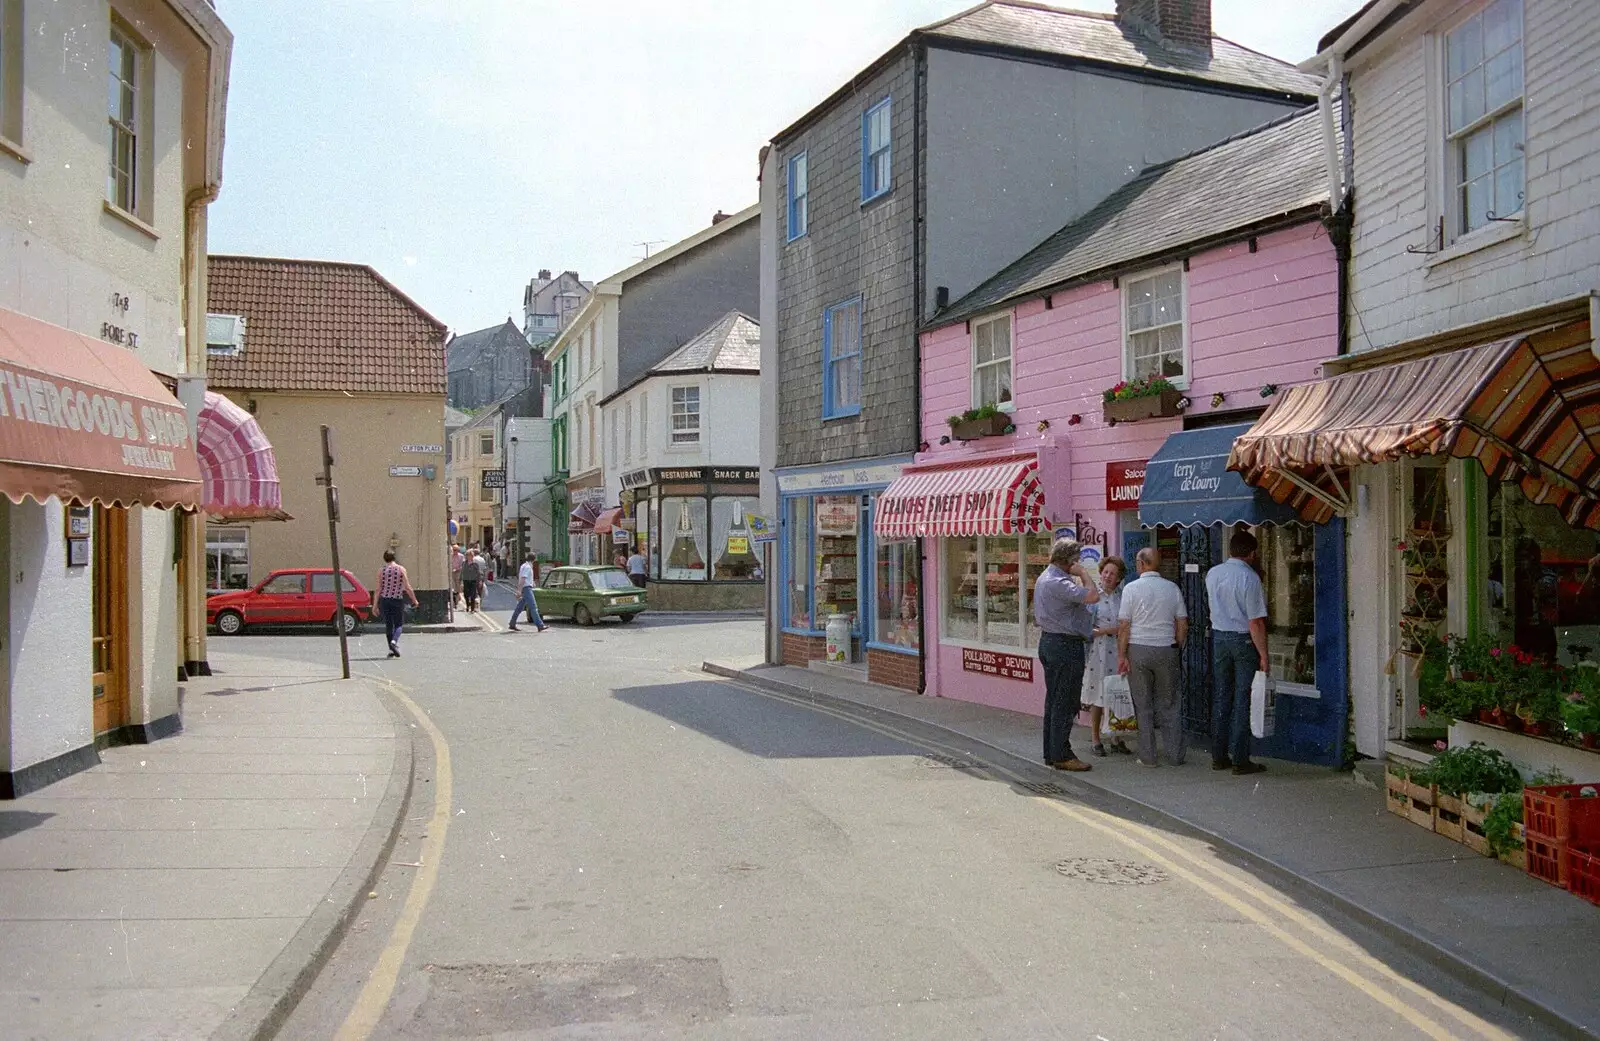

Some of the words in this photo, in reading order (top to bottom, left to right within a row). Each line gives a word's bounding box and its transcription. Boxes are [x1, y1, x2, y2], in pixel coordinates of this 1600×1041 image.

[102, 321, 125, 343] FORE
[141, 405, 188, 449] SHOP
[660, 470, 702, 479] RESTAURANT
[714, 471, 741, 479] SNACK
[744, 471, 760, 479] BAR
[928, 494, 961, 513] SWEET
[965, 491, 994, 512] SHOP
[1010, 517, 1043, 528] SHOP
[964, 650, 996, 665] POLLARDS
[1005, 656, 1031, 670] DEVON
[983, 665, 997, 673] CREAM
[1012, 670, 1030, 679] CREAM
